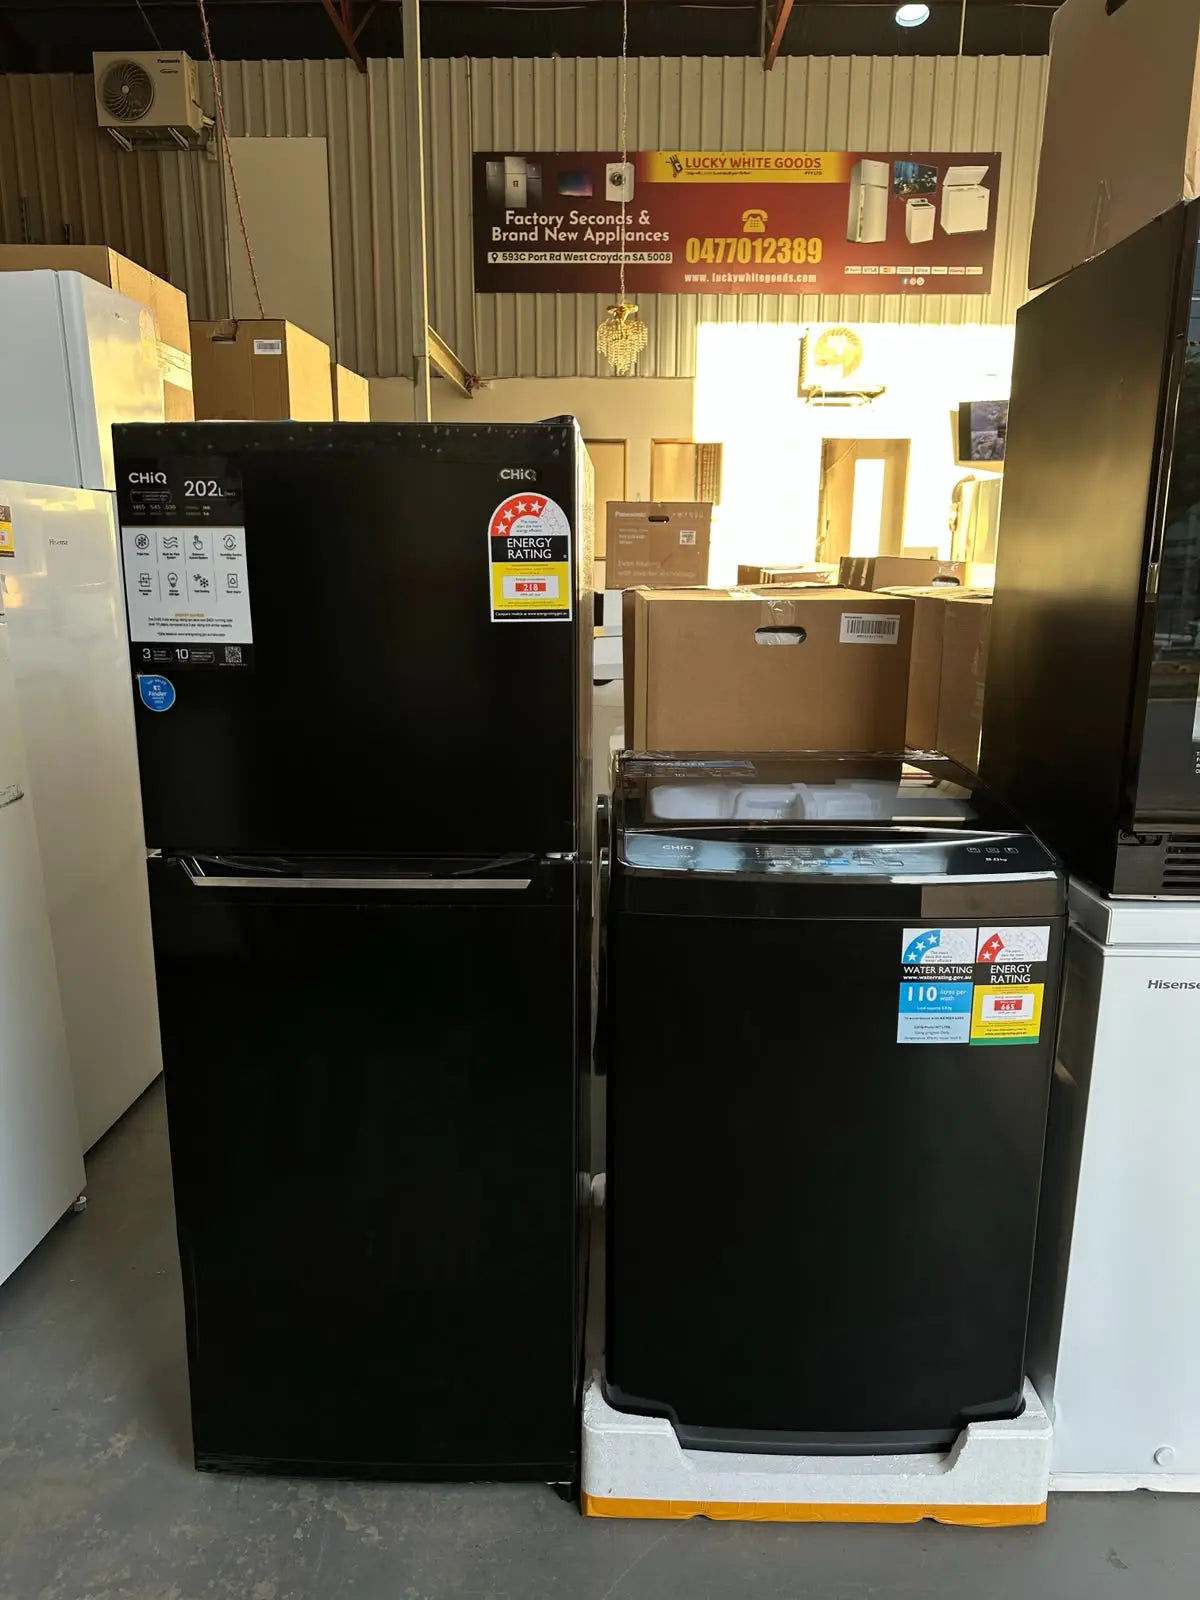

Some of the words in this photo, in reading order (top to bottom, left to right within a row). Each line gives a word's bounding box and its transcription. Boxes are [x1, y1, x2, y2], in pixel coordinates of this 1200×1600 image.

[685, 157, 727, 168] LUCKY
[730, 157, 772, 168] WHITE
[774, 157, 822, 168] GOODS
[505, 210, 564, 229] Factory
[569, 210, 633, 225] Seconds
[638, 210, 650, 225] &
[491, 227, 539, 242] Brand
[544, 227, 580, 242] New
[584, 227, 670, 245] Appliances
[685, 237, 823, 264] 0477012389
[502, 252, 526, 262] 593C
[528, 252, 548, 262] Port
[550, 252, 562, 262] Rd
[564, 252, 588, 262] West
[590, 252, 631, 264] Croydon
[632, 252, 646, 262] SA
[647, 252, 671, 262] 5008
[712, 272, 817, 284] luckywhitegoods.com
[128, 472, 168, 484] CHiQ
[500, 468, 537, 480] CHiQ
[506, 538, 552, 548] ENERGY
[508, 549, 552, 559] RATING
[142, 648, 151, 659] 3
[175, 648, 189, 660] 10
[904, 966, 936, 974] WATER
[938, 966, 973, 974] RATING
[990, 964, 1032, 974] ENERGY
[990, 974, 1031, 984] RATING
[908, 986, 938, 1002] 110
